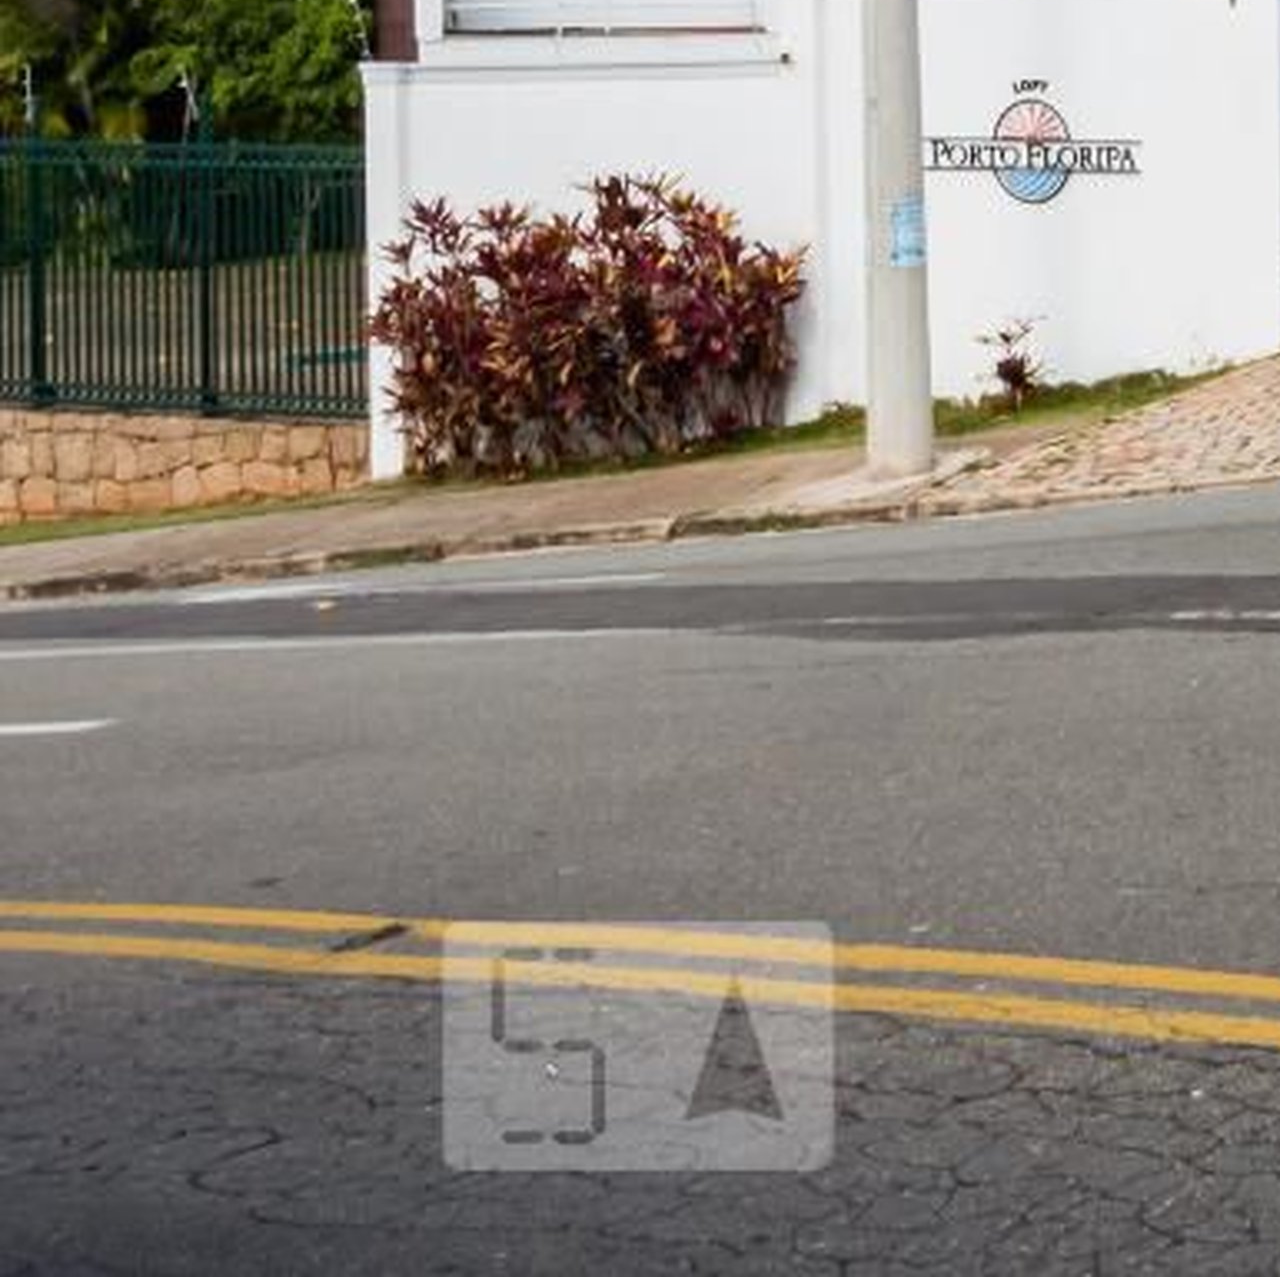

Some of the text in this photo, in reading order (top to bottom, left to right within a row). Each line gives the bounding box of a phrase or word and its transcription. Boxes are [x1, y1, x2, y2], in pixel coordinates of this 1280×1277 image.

[1012, 79, 1048, 94] LOFT
[931, 139, 1136, 171] PORTO FLORIPA
